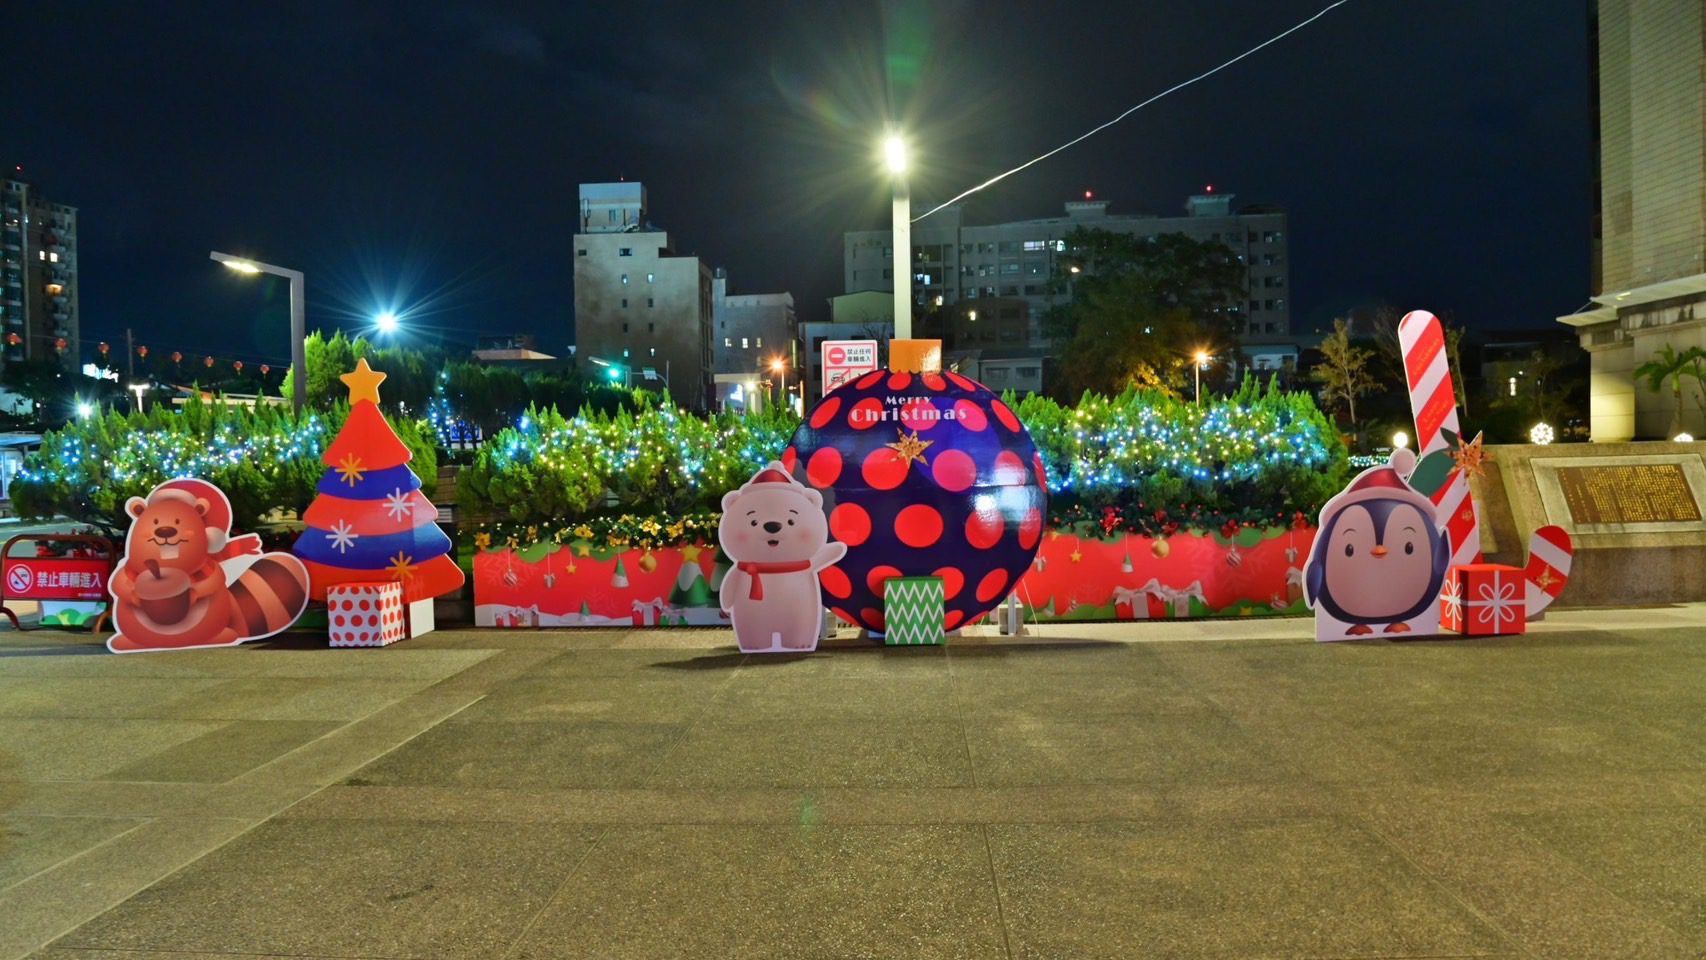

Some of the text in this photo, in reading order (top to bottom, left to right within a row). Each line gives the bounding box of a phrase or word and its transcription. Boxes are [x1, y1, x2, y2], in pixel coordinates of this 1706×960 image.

[885, 396, 932, 405] Merry
[851, 408, 968, 421] Christmas
[37, 571, 102, 588] 禁止車輛進入
